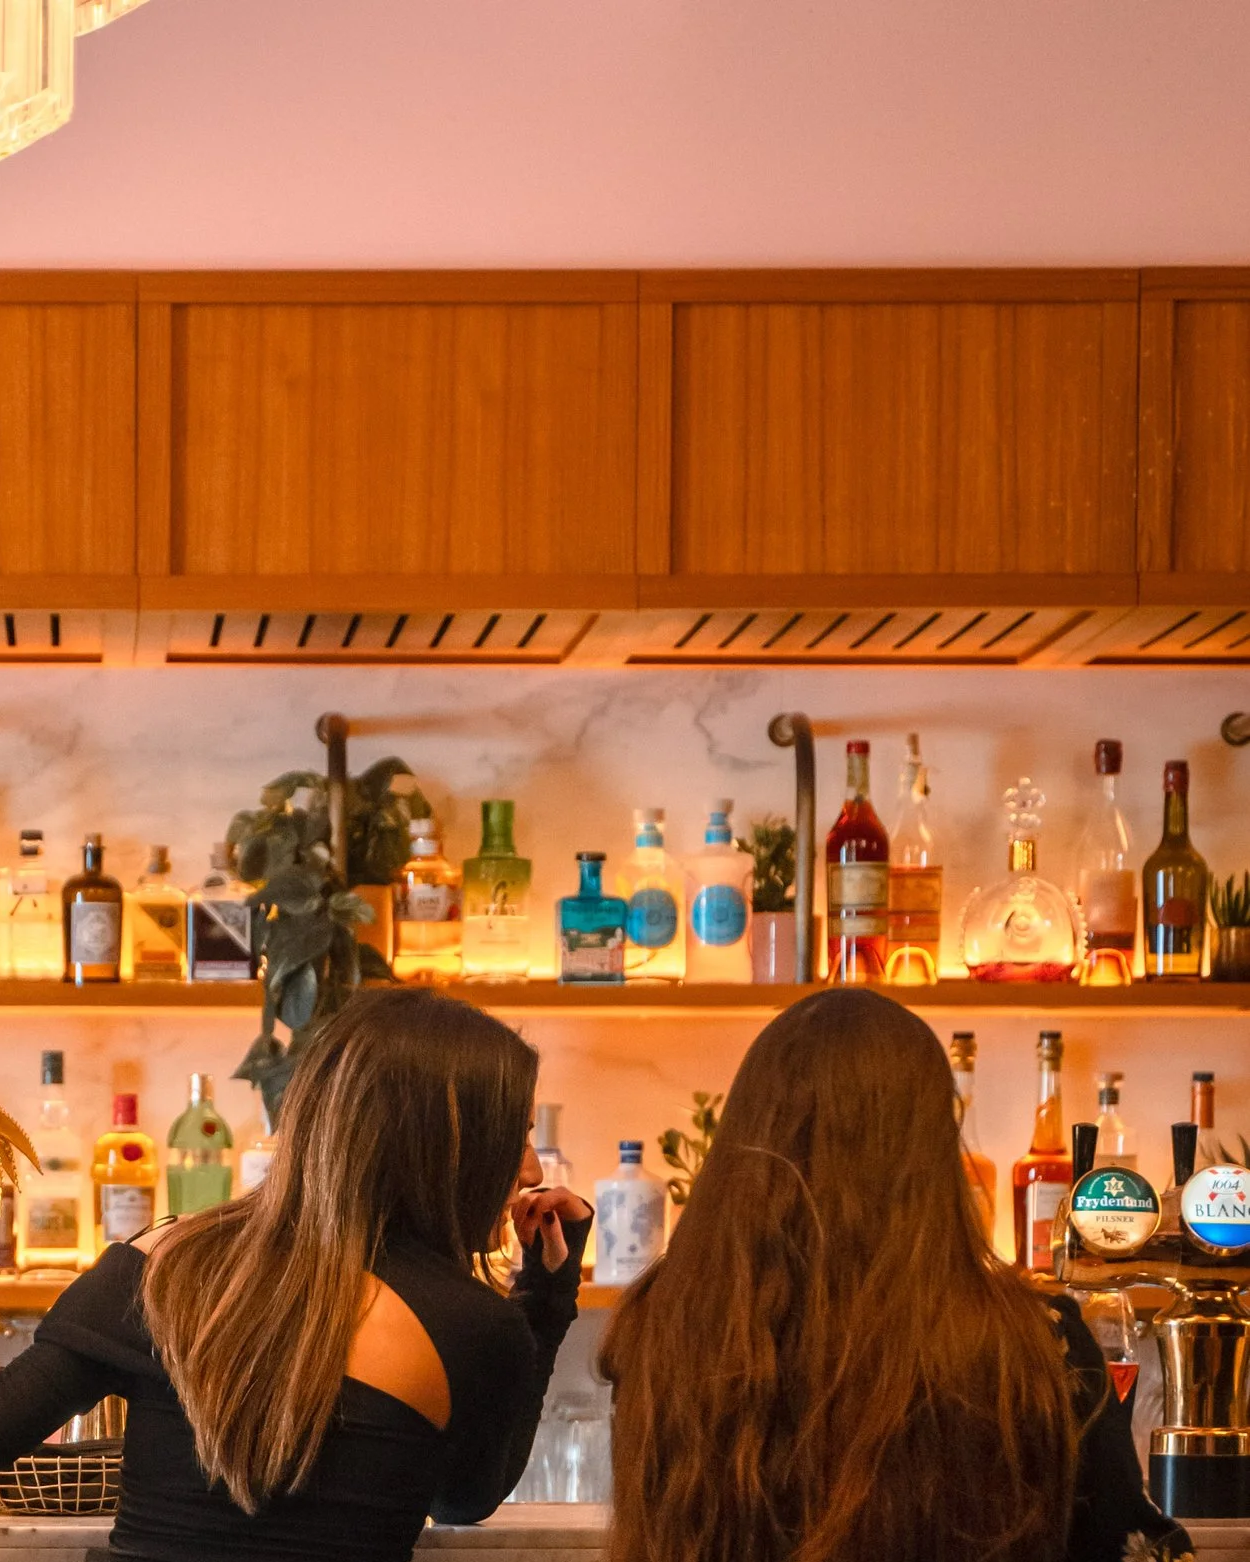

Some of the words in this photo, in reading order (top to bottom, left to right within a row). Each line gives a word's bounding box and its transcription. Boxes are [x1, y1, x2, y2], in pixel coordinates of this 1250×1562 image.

[1075, 1195, 1154, 1209] Frydenlund
[1195, 1203, 1250, 1217] BLAN
[1095, 1215, 1135, 1223] PILSNER
